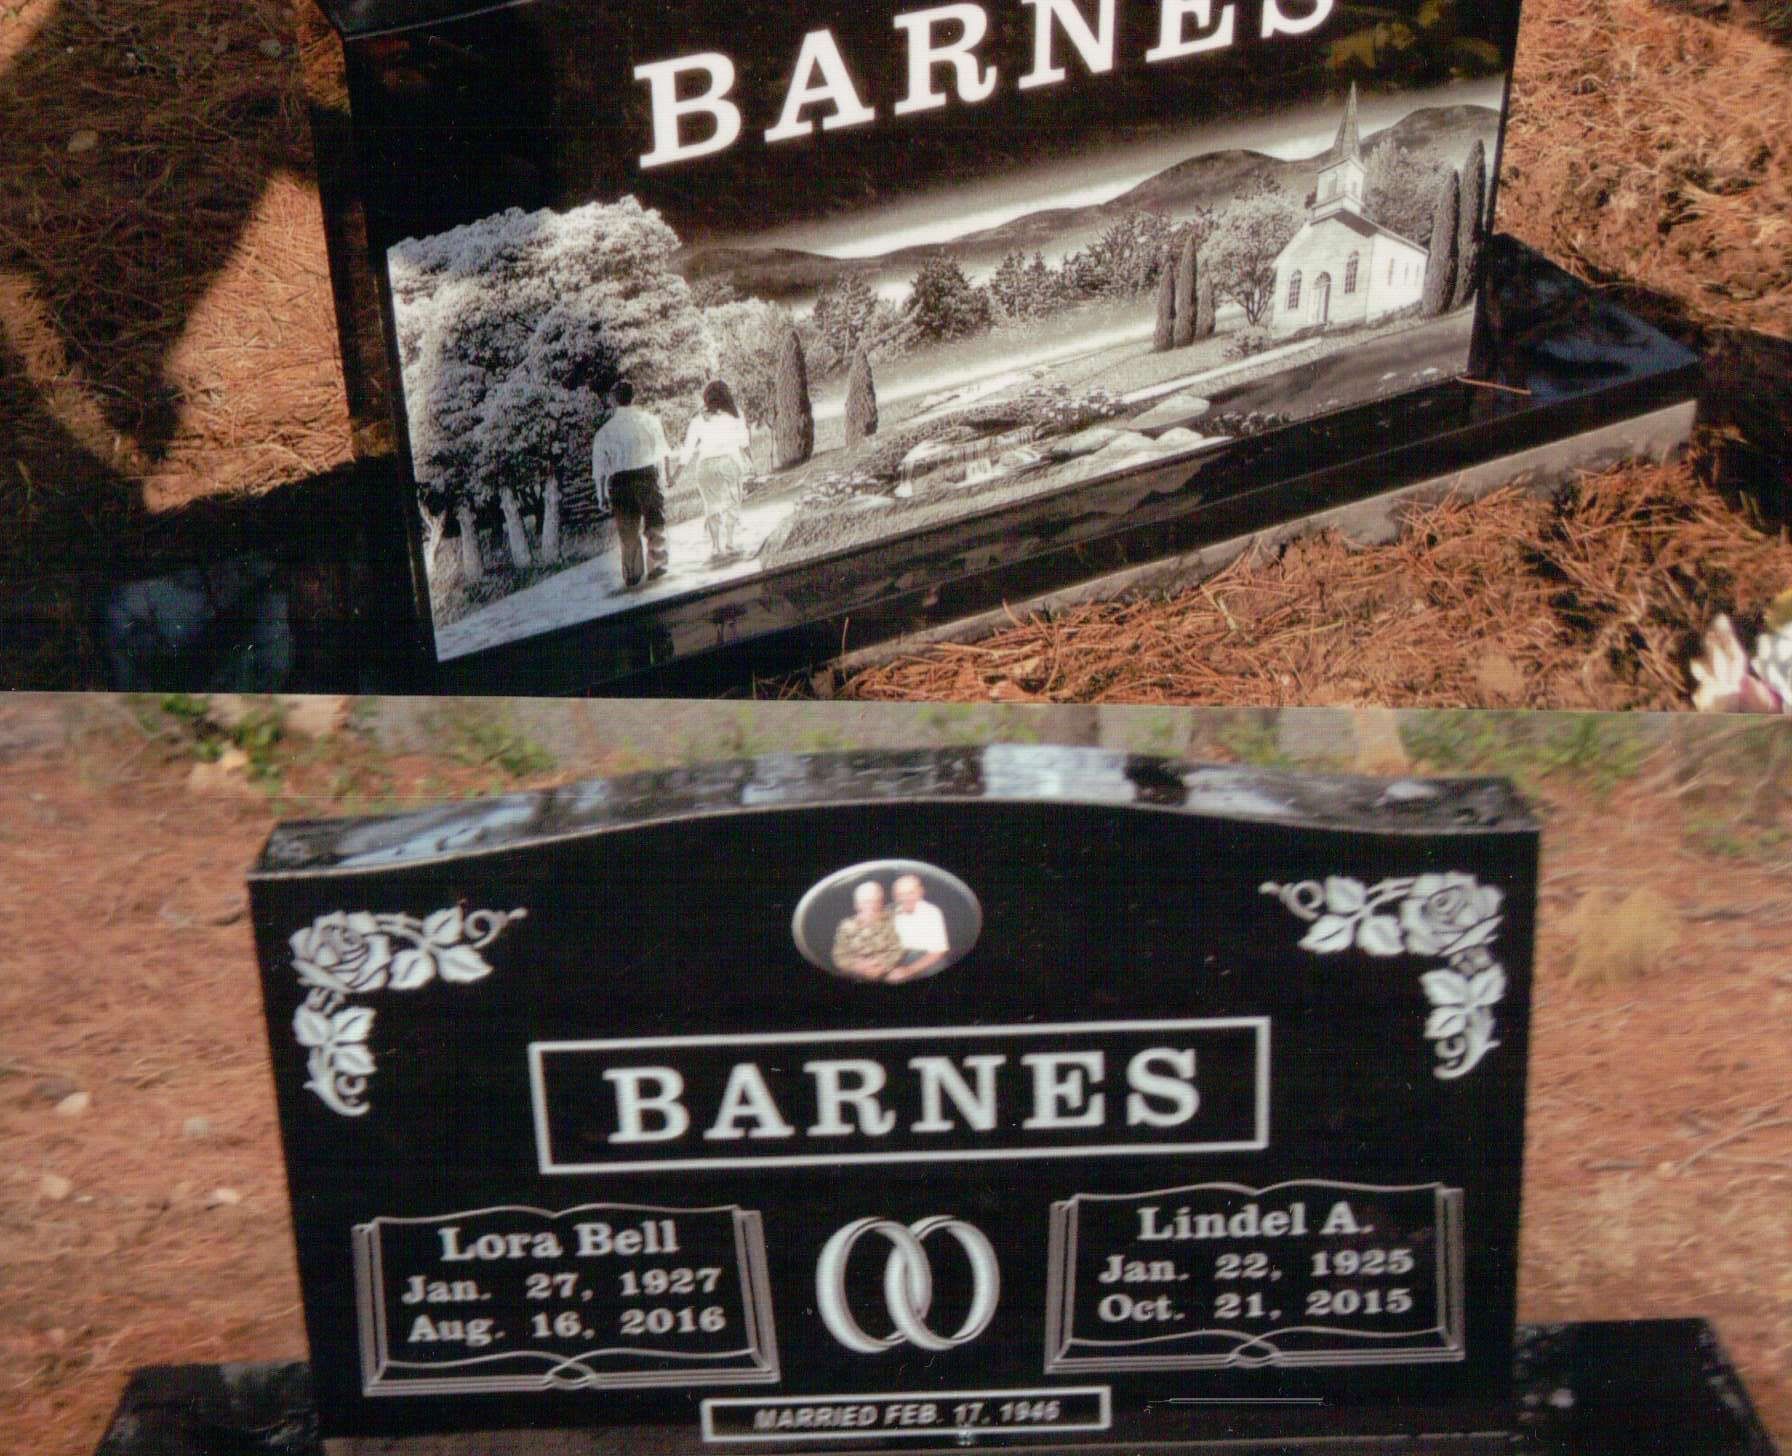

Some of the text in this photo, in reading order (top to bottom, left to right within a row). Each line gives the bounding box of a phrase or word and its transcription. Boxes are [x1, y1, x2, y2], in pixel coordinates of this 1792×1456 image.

[602, 1048, 1201, 1144] BARNES
[1136, 1201, 1375, 1241] Lindel A.
[438, 1219, 681, 1262] Lora Bell
[1100, 1248, 1416, 1283] Jan. 22, 1925
[401, 1267, 723, 1304] Jan. 27, 1927
[1099, 1289, 1413, 1323] Oct. 21, 2015
[408, 1315, 506, 1347] Aug.
[620, 1306, 727, 1336] 2016
[753, 1404, 878, 1429] MARRIED
[884, 1403, 944, 1425] FEB.
